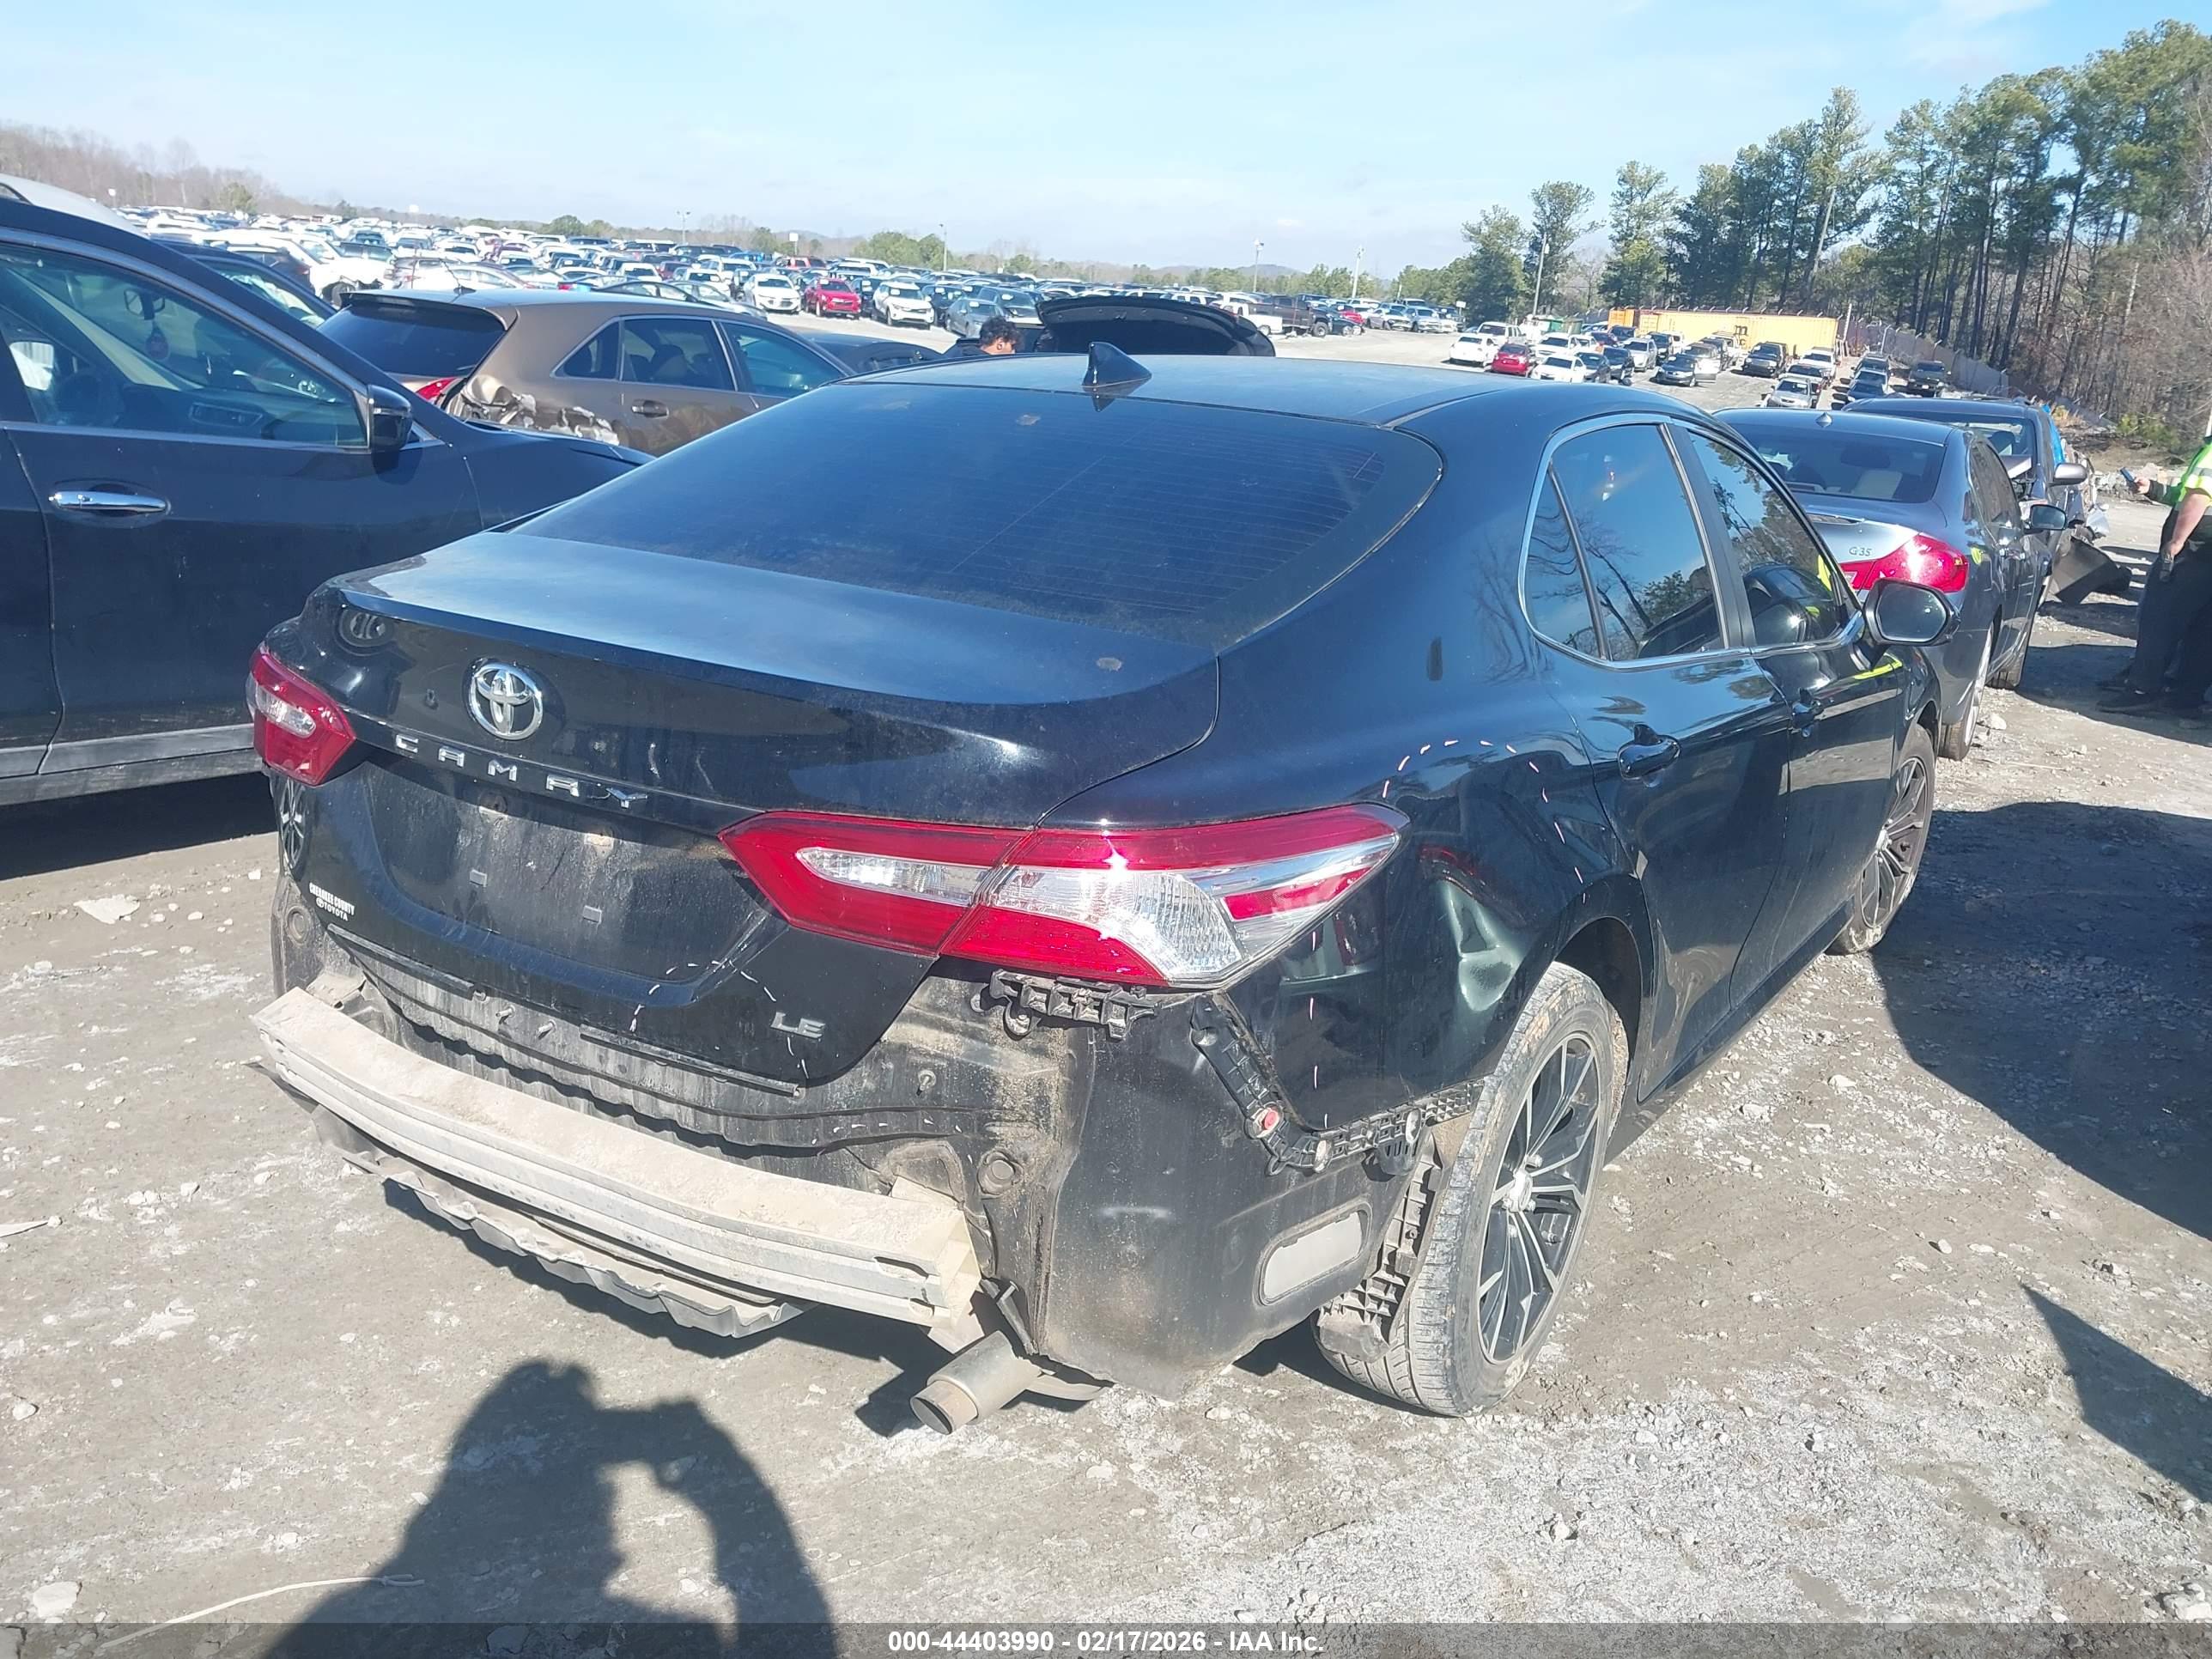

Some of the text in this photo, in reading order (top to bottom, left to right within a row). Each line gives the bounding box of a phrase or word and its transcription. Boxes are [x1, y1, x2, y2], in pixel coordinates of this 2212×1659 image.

[1849, 546, 1872, 557] G35
[395, 733, 648, 809] CAMRY
[324, 902, 349, 921] TOYOTA
[770, 1012, 826, 1039] LE
